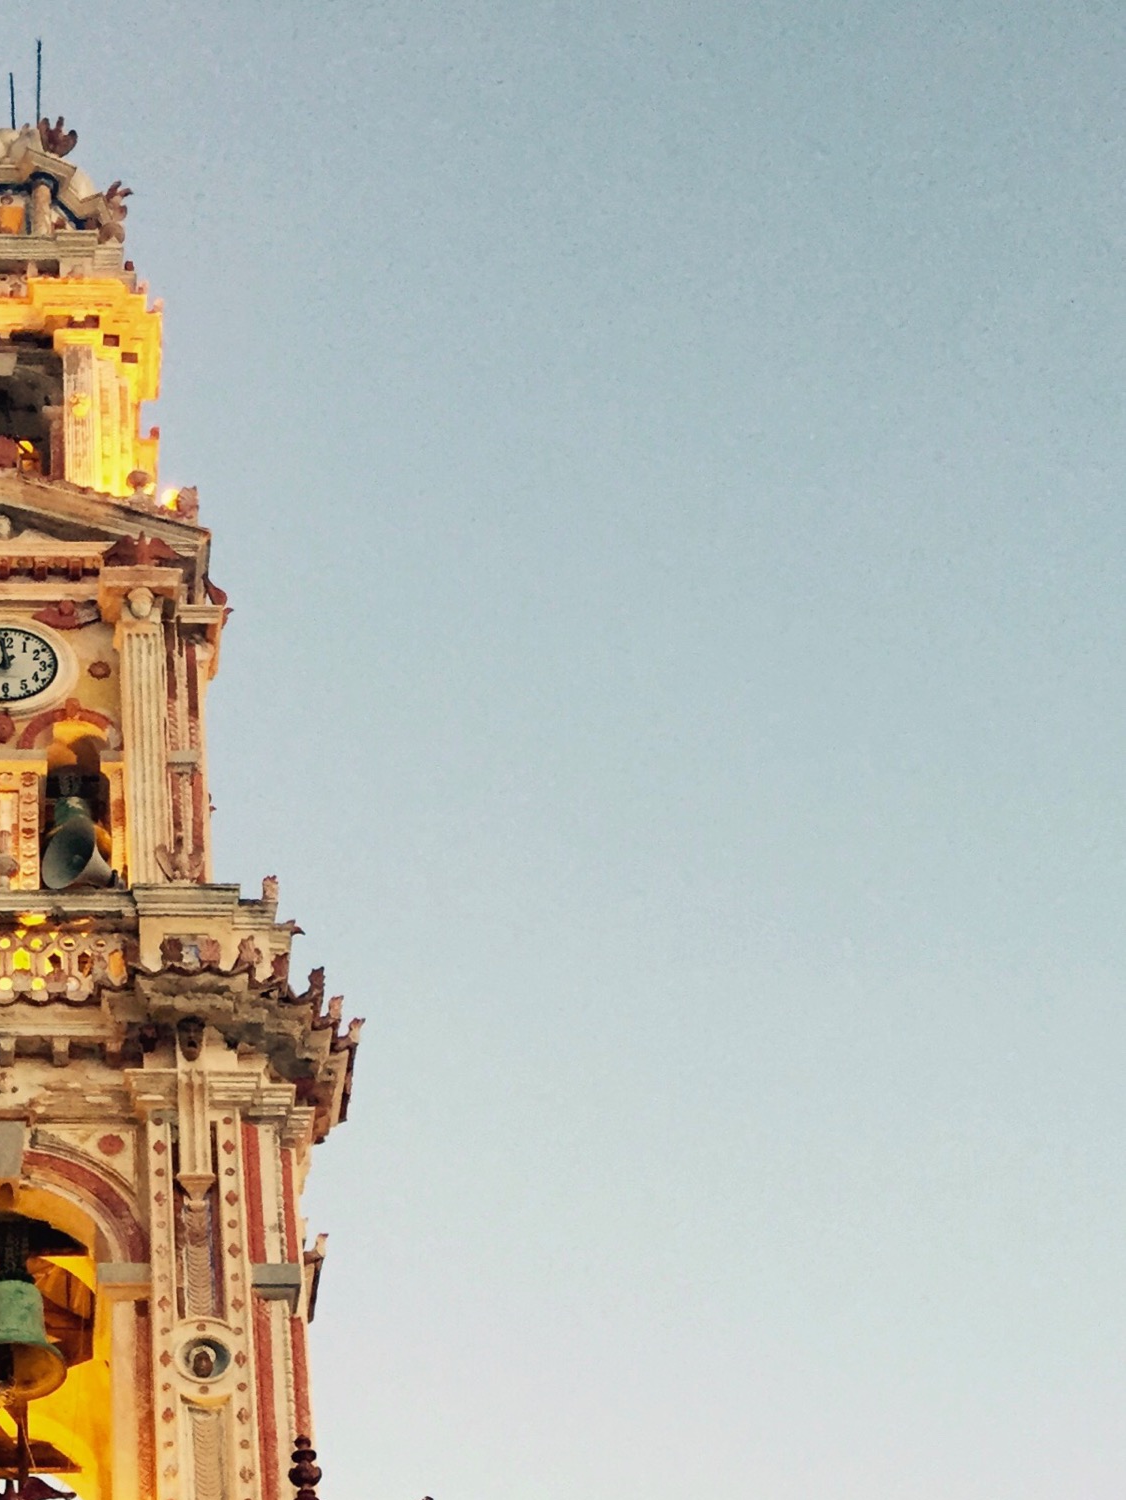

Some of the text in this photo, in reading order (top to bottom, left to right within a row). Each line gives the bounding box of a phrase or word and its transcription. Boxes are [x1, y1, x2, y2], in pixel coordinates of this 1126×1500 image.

[0, 637, 14, 649] 2
[22, 641, 27, 653] 1
[32, 649, 40, 661] 2
[39, 660, 47, 672] 3
[32, 671, 39, 683] 4
[1, 682, 9, 693] 6
[20, 679, 28, 690] 5
